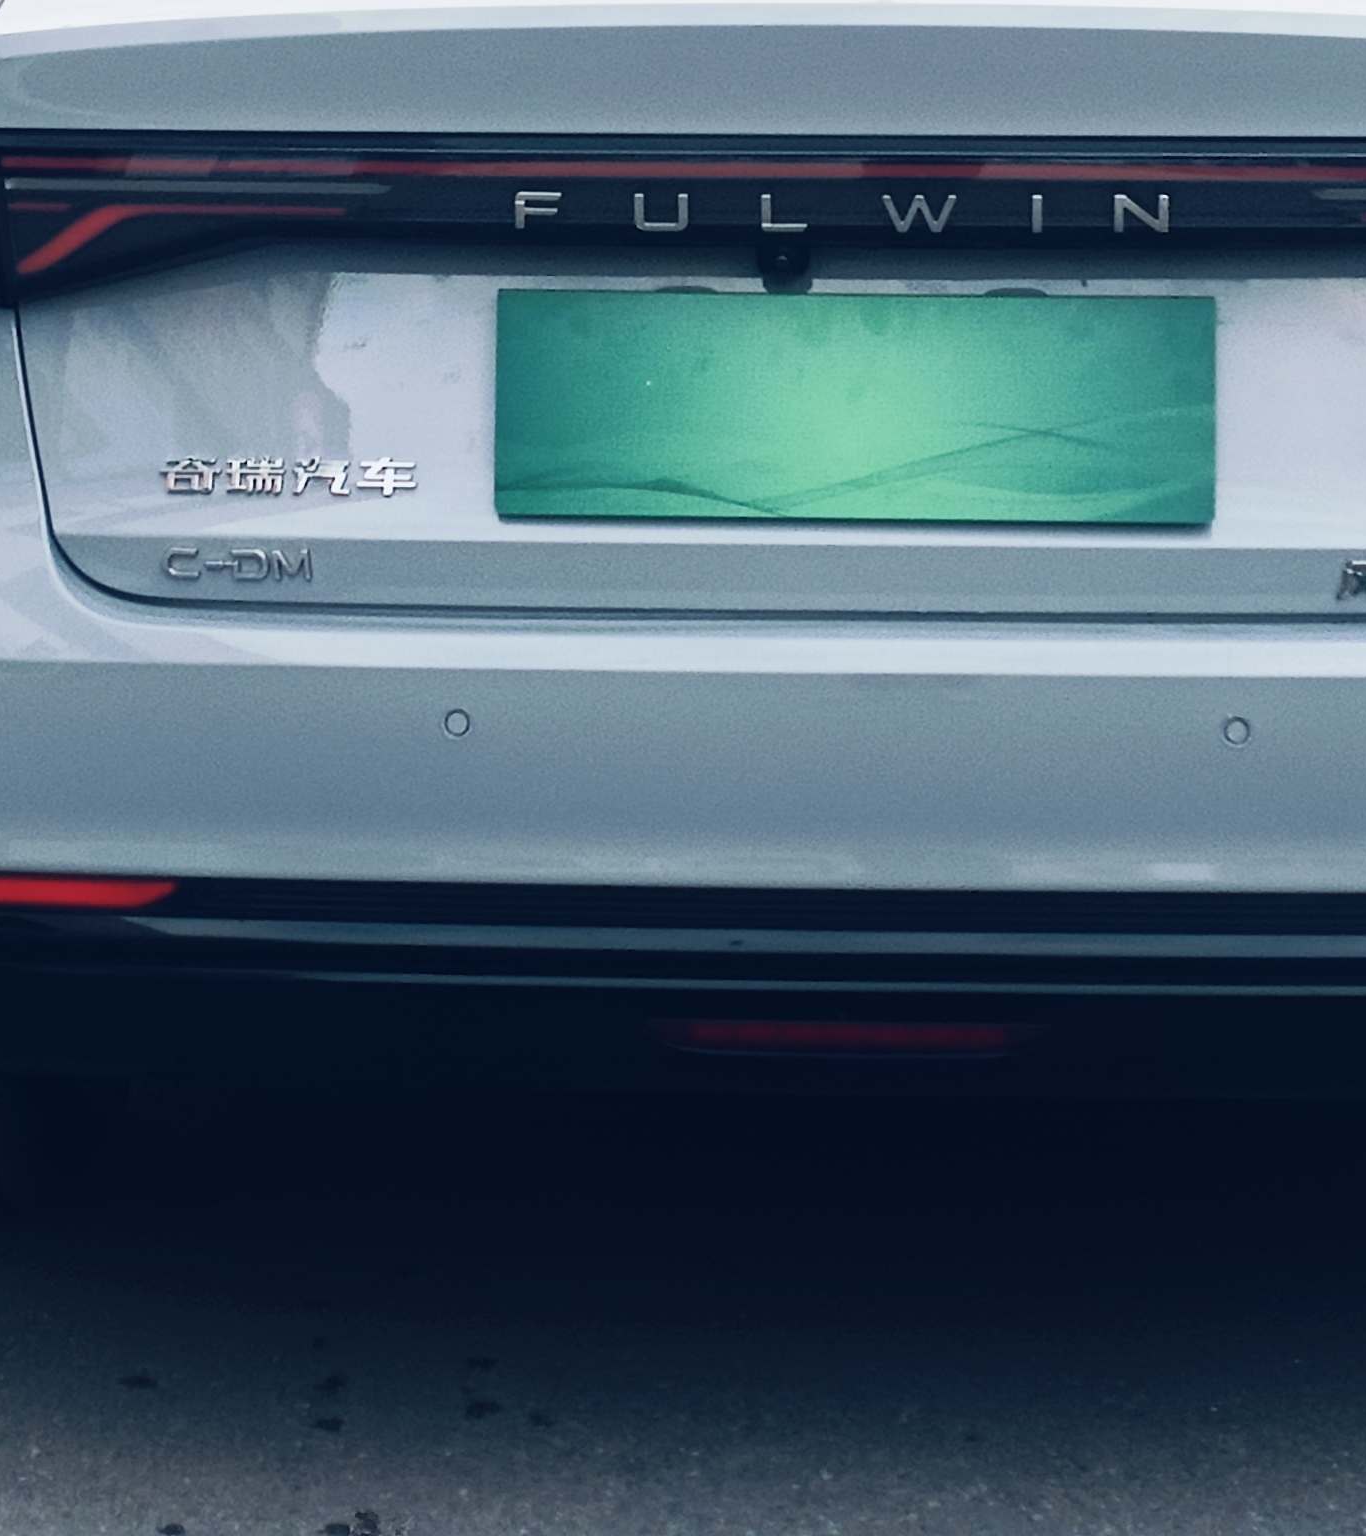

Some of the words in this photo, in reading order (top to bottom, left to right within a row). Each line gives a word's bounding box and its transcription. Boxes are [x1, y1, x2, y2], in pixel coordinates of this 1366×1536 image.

[514, 190, 1171, 235] FULWIN
[160, 455, 418, 498] 奇瑞汽车
[164, 546, 314, 583] C-DM
